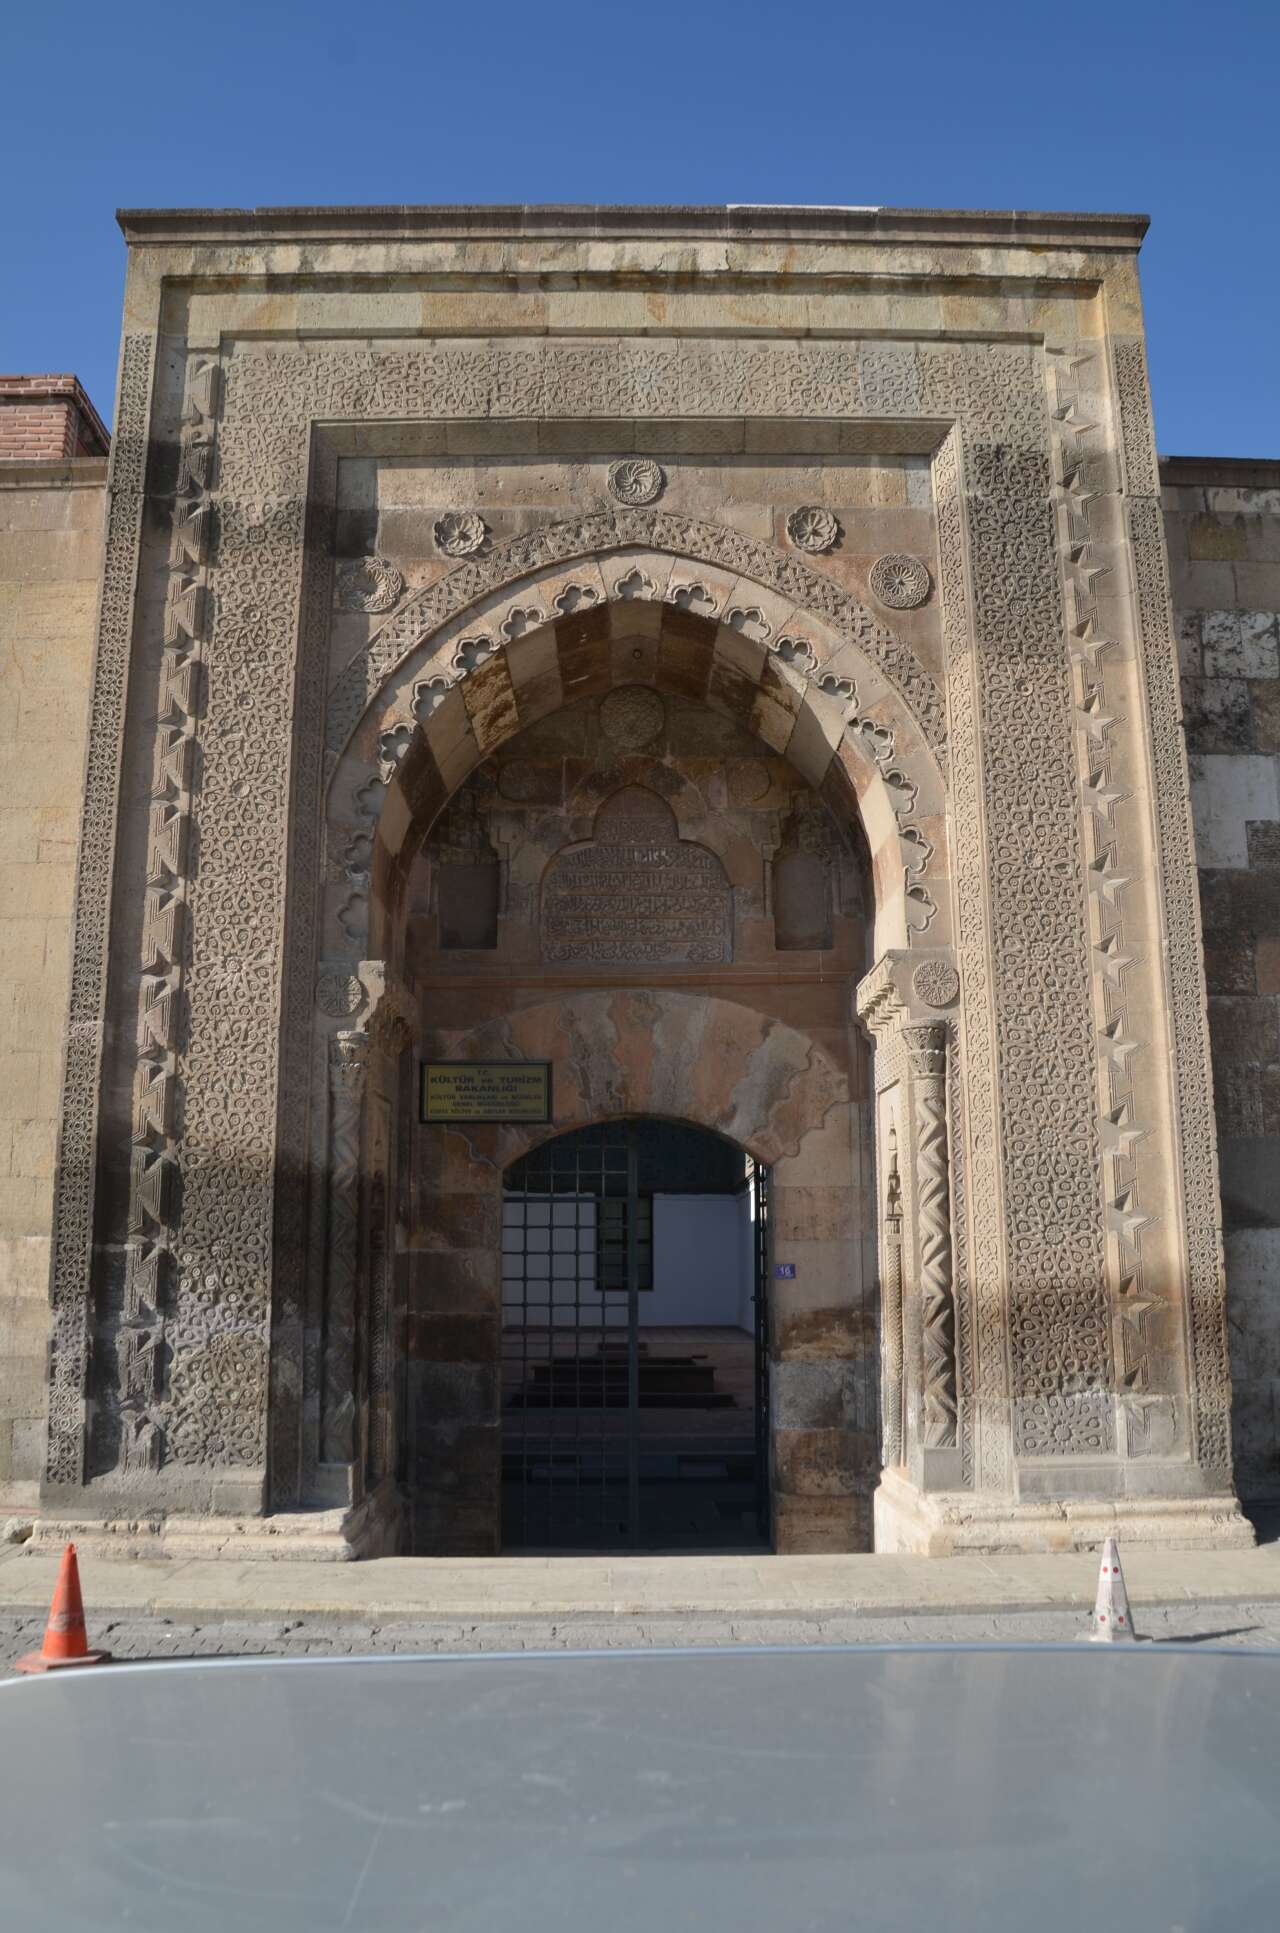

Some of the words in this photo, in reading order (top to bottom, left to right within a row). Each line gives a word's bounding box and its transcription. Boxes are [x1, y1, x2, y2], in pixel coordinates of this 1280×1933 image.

[430, 1074, 474, 1084] KÜLTÜR
[499, 1074, 543, 1084] TURİZM
[455, 1084, 518, 1092] BAKANLIĞI
